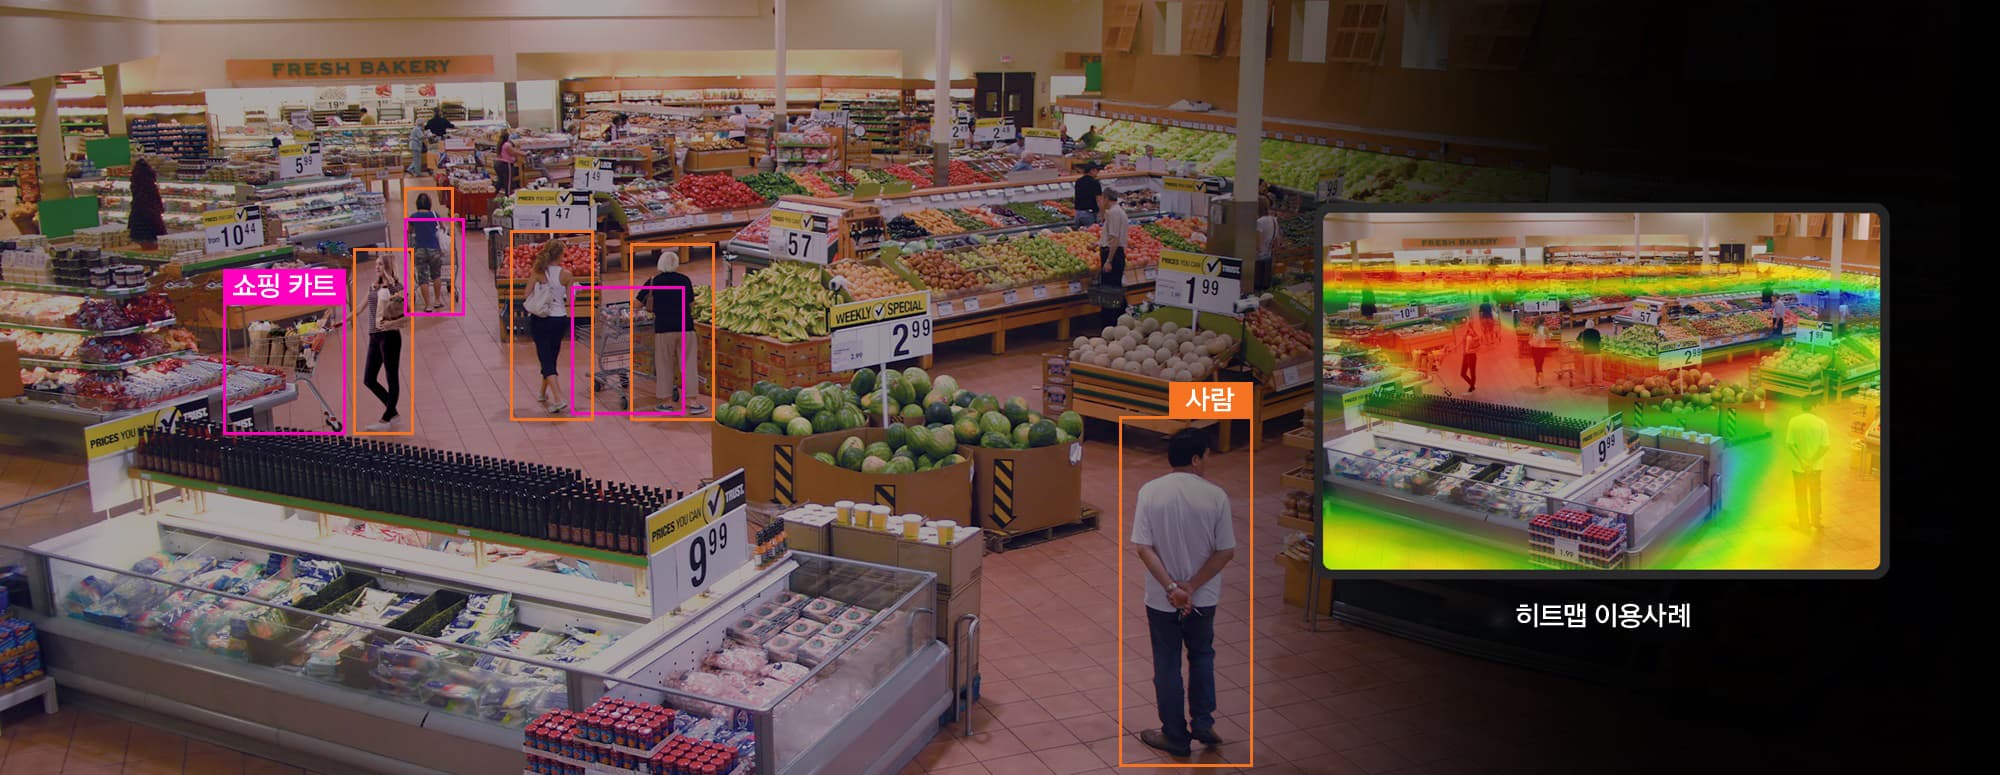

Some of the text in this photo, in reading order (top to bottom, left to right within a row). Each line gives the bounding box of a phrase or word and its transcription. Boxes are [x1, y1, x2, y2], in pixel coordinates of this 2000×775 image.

[271, 60, 451, 77] FRESH BAKERY
[788, 232, 811, 257] 57
[835, 300, 924, 324] WEEKLY SPECIAL
[90, 433, 120, 448] PRICES
[120, 427, 137, 440] YOU
[652, 521, 676, 542] PRICES
[675, 515, 689, 528] YOU
[688, 507, 702, 522] CAN
